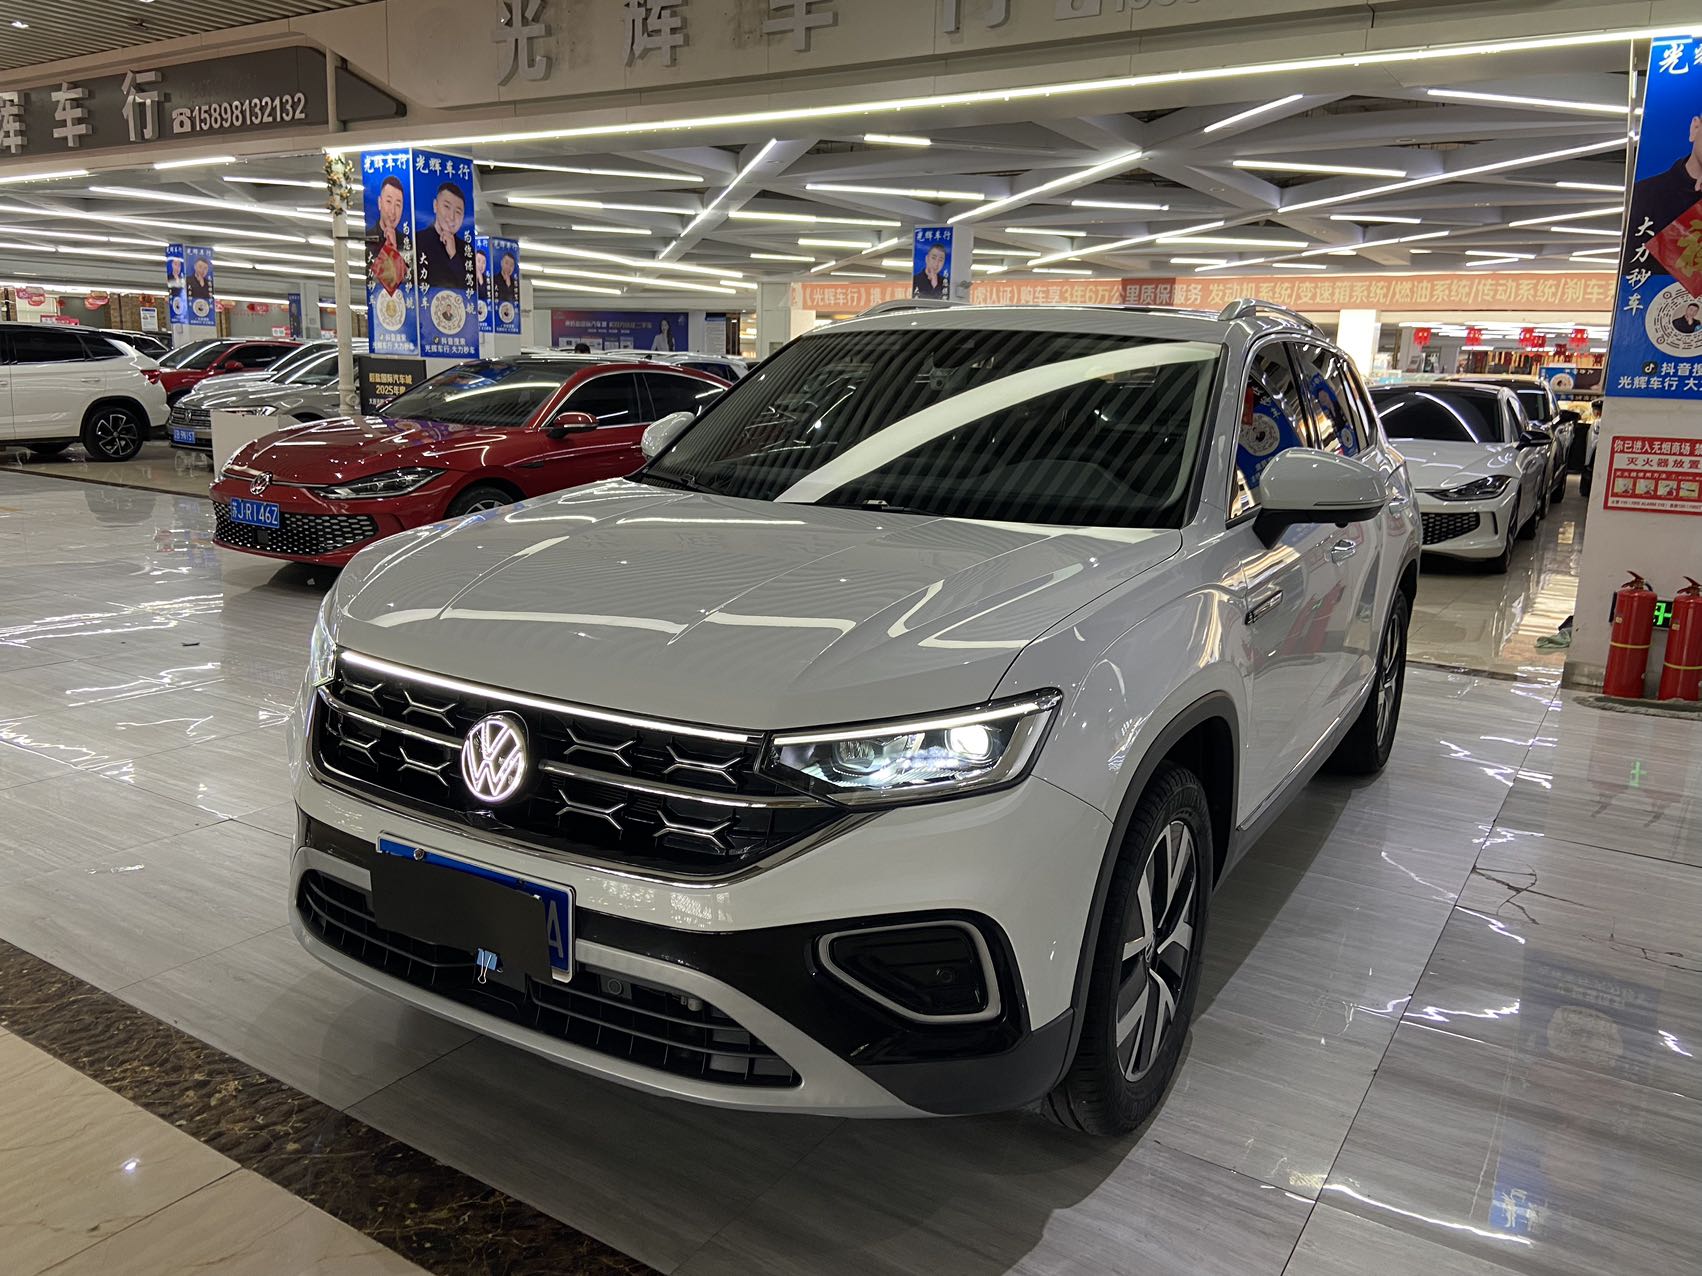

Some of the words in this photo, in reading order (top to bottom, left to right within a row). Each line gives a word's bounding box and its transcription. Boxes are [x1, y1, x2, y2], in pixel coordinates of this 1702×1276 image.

[1659, 43, 1702, 74] 光
[192, 92, 306, 131] 15898132132
[364, 153, 409, 173] 光辉车行
[416, 154, 470, 180] 光辉车行
[1618, 376, 1679, 391] 光辉车行
[1683, 378, 1702, 391] 大
